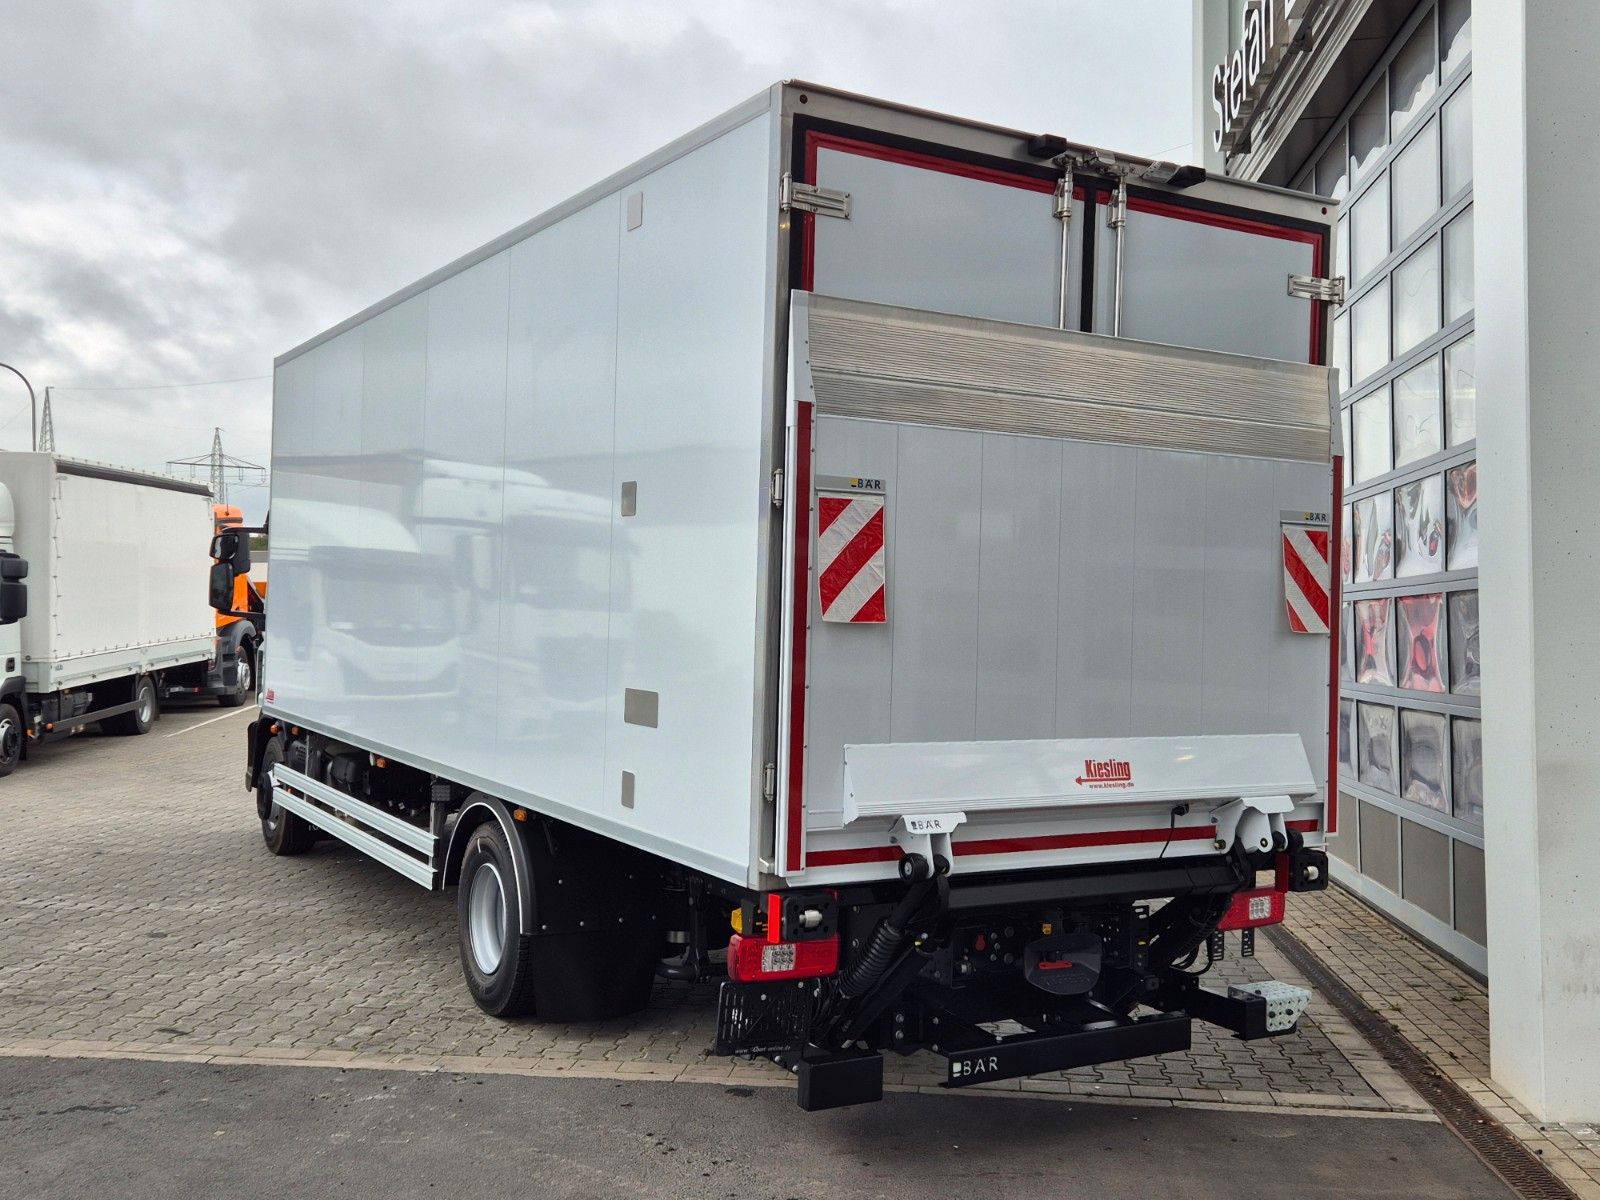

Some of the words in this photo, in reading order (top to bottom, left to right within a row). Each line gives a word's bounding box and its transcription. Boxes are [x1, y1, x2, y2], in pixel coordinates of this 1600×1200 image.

[1212, 0, 1274, 152] Stefan
[858, 479, 881, 489] BÄR
[1084, 759, 1131, 780] Kiesling
